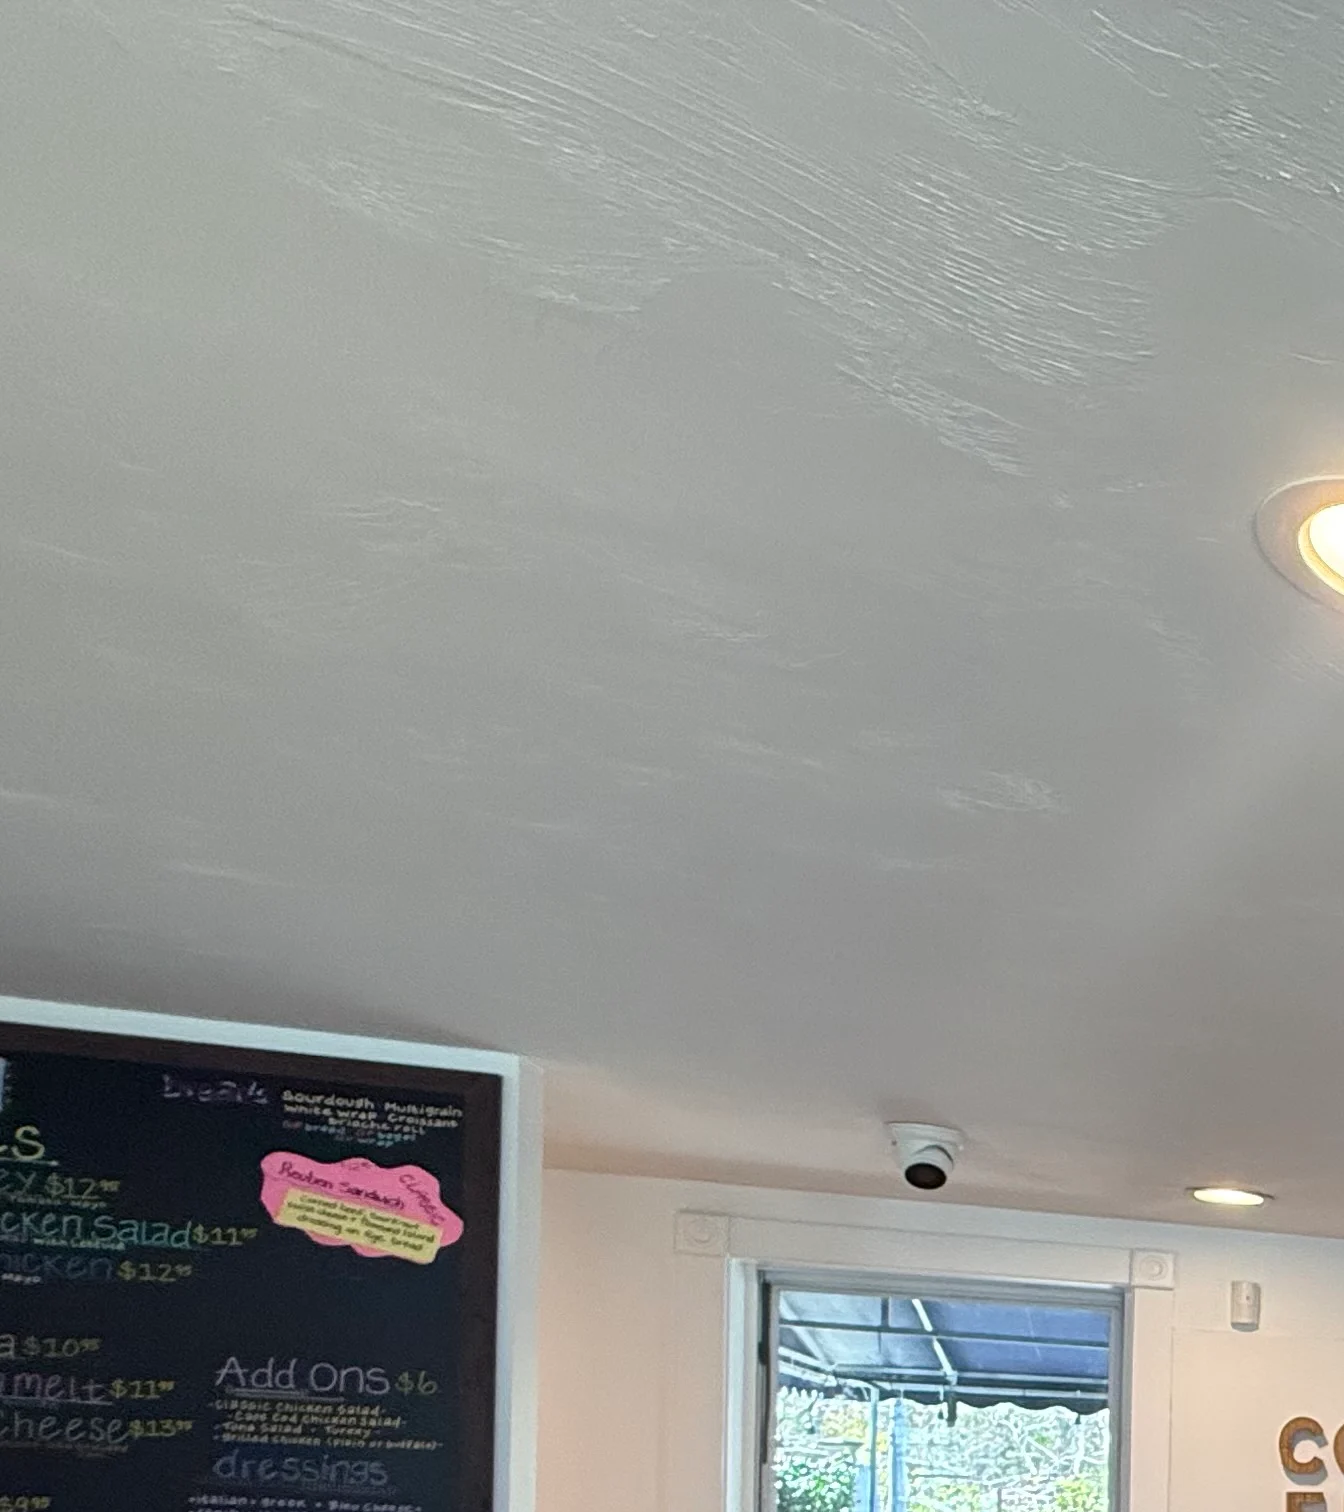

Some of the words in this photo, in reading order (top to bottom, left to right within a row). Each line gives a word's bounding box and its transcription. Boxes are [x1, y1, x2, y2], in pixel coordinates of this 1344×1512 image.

[282, 1090, 376, 1110] Sourdough
[384, 1102, 463, 1118] Multigrain
[90, 1215, 193, 1249] Salad
[214, 1356, 298, 1391] Add
[307, 1361, 392, 1396] Ons
[394, 1371, 439, 1397] $6
[211, 1450, 390, 1487] dressings
